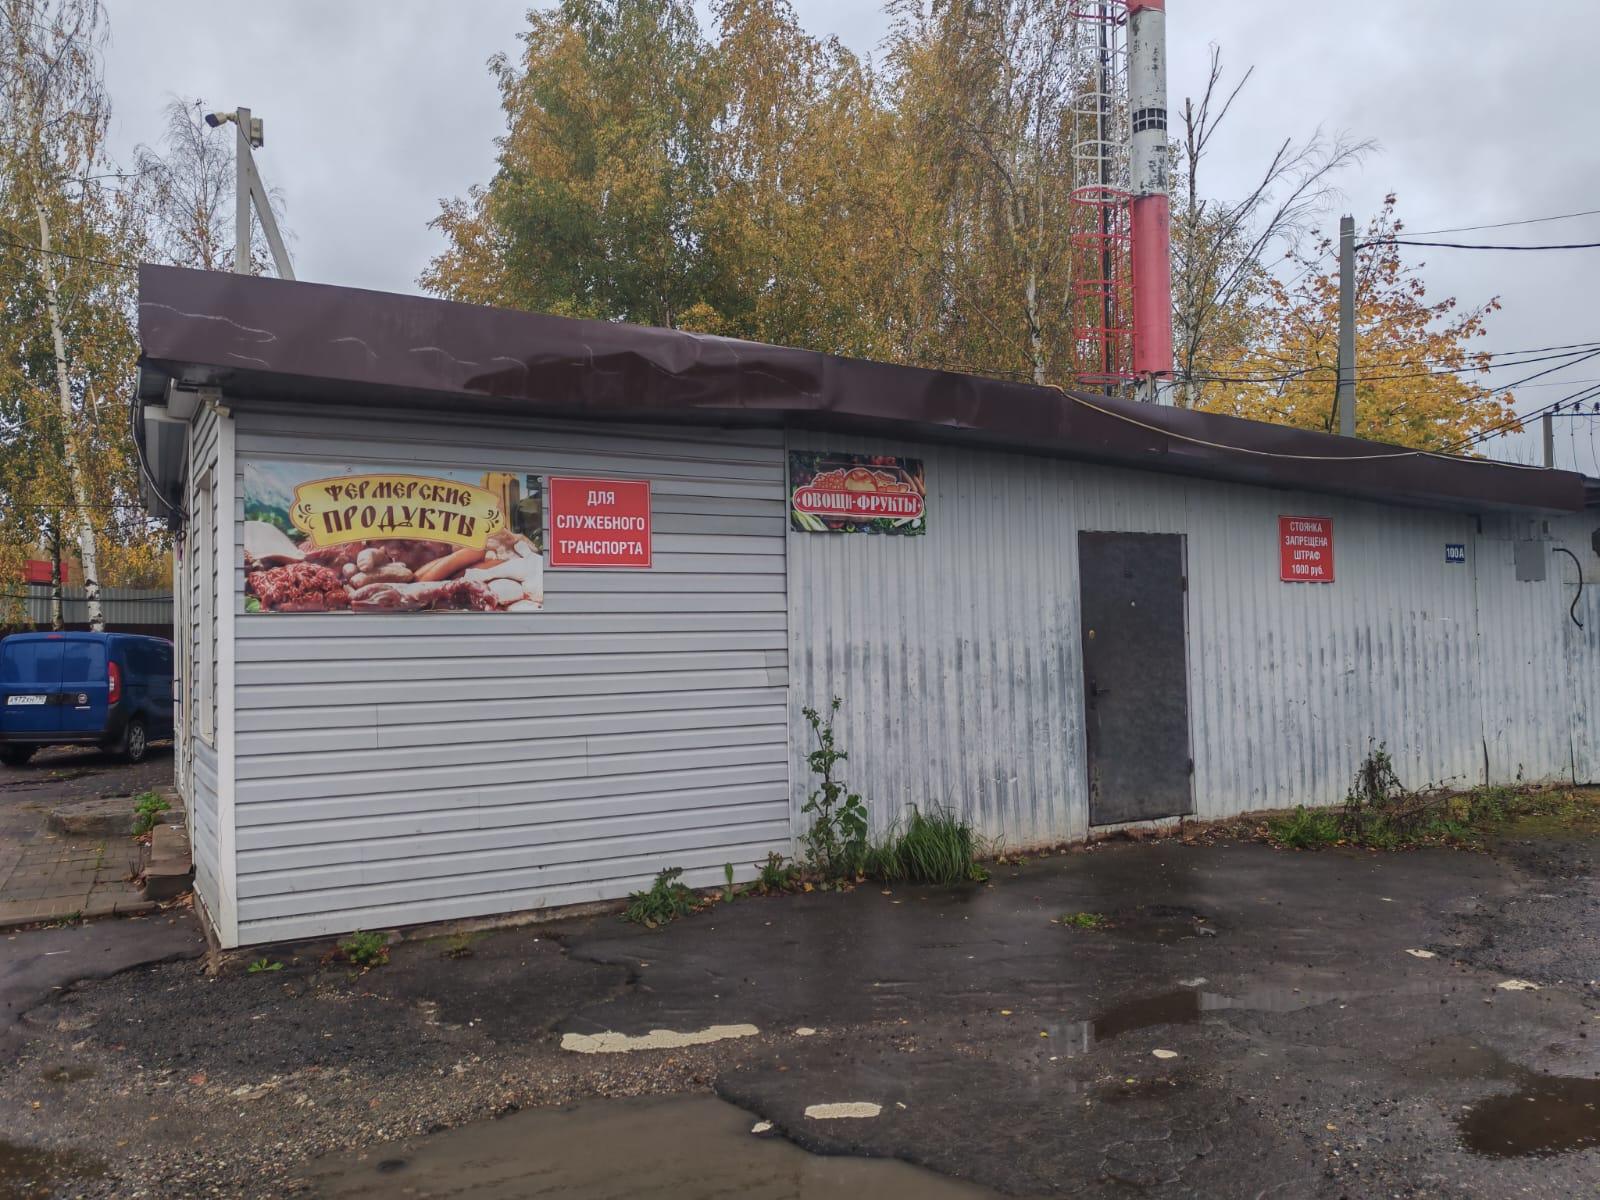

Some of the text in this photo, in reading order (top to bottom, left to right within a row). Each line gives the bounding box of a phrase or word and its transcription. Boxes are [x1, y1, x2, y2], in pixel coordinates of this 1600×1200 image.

[324, 480, 472, 507] ФЕРМЕРСКИЕ
[586, 490, 616, 506] ДЛЯ
[801, 492, 917, 513] ОВОЩИ-ФРУКТЫ
[322, 504, 477, 538] ПРОДУКТЫ
[556, 514, 646, 532] СЛУЖЕБНОГО
[1289, 521, 1323, 533] СТОЯНКА
[558, 540, 645, 556] ТРАНСПОРТА
[1285, 535, 1328, 548] ЗАПРЕЩЕНА
[1294, 550, 1321, 561] ШТРАФ
[1291, 563, 1325, 577] 1000 руб.
